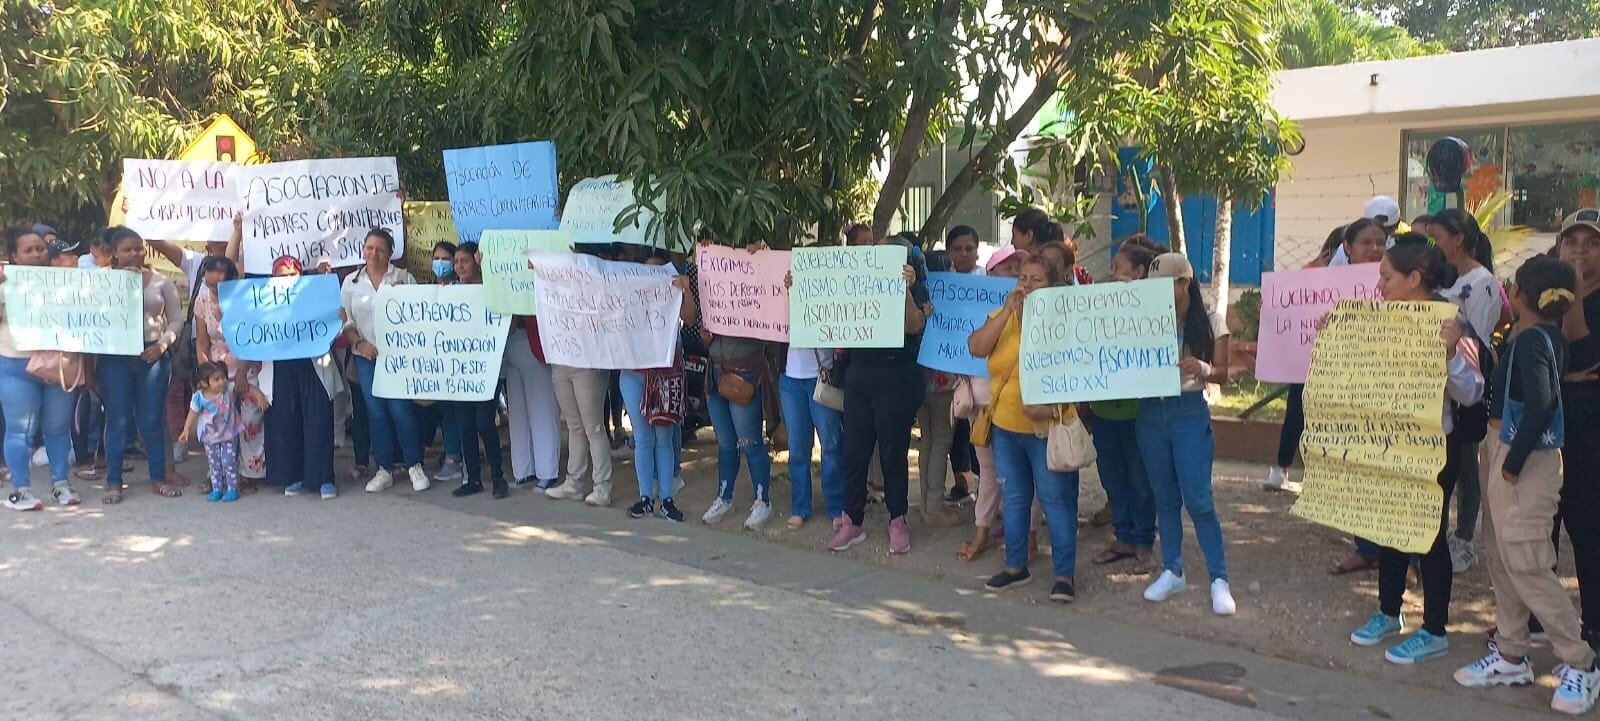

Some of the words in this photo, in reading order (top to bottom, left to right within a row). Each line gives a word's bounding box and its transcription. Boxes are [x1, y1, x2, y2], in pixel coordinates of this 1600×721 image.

[139, 166, 166, 190] NO
[182, 169, 194, 189] A
[204, 170, 224, 189] LA
[512, 160, 532, 180] DE
[244, 175, 368, 210] ASOCIACION
[370, 173, 395, 195] DE
[253, 211, 309, 238] MADRES
[794, 249, 858, 272] QUEREMOS
[863, 249, 883, 269] EL
[799, 275, 837, 302] MISMO
[844, 274, 904, 297] OPERADOR
[1271, 283, 1341, 309] LUCHANDO
[1354, 283, 1384, 304] POR
[385, 299, 472, 325] QUEREMOS
[803, 299, 881, 328] ASOMADRES
[1055, 288, 1141, 322] queremos
[119, 312, 129, 330] Y
[645, 309, 666, 331] 13
[1277, 317, 1291, 334] LA
[235, 320, 328, 346] CORRUPTO
[385, 330, 426, 349] MISMA
[819, 325, 850, 342] SIGLO
[855, 326, 873, 341] XXI
[1031, 319, 1066, 346] otro
[385, 355, 408, 374] QUE
[413, 356, 444, 375] OPERA
[451, 358, 487, 376] DESDE
[1024, 345, 1094, 373] queremos
[406, 377, 440, 395] HACEN
[1084, 375, 1109, 391] XXI
